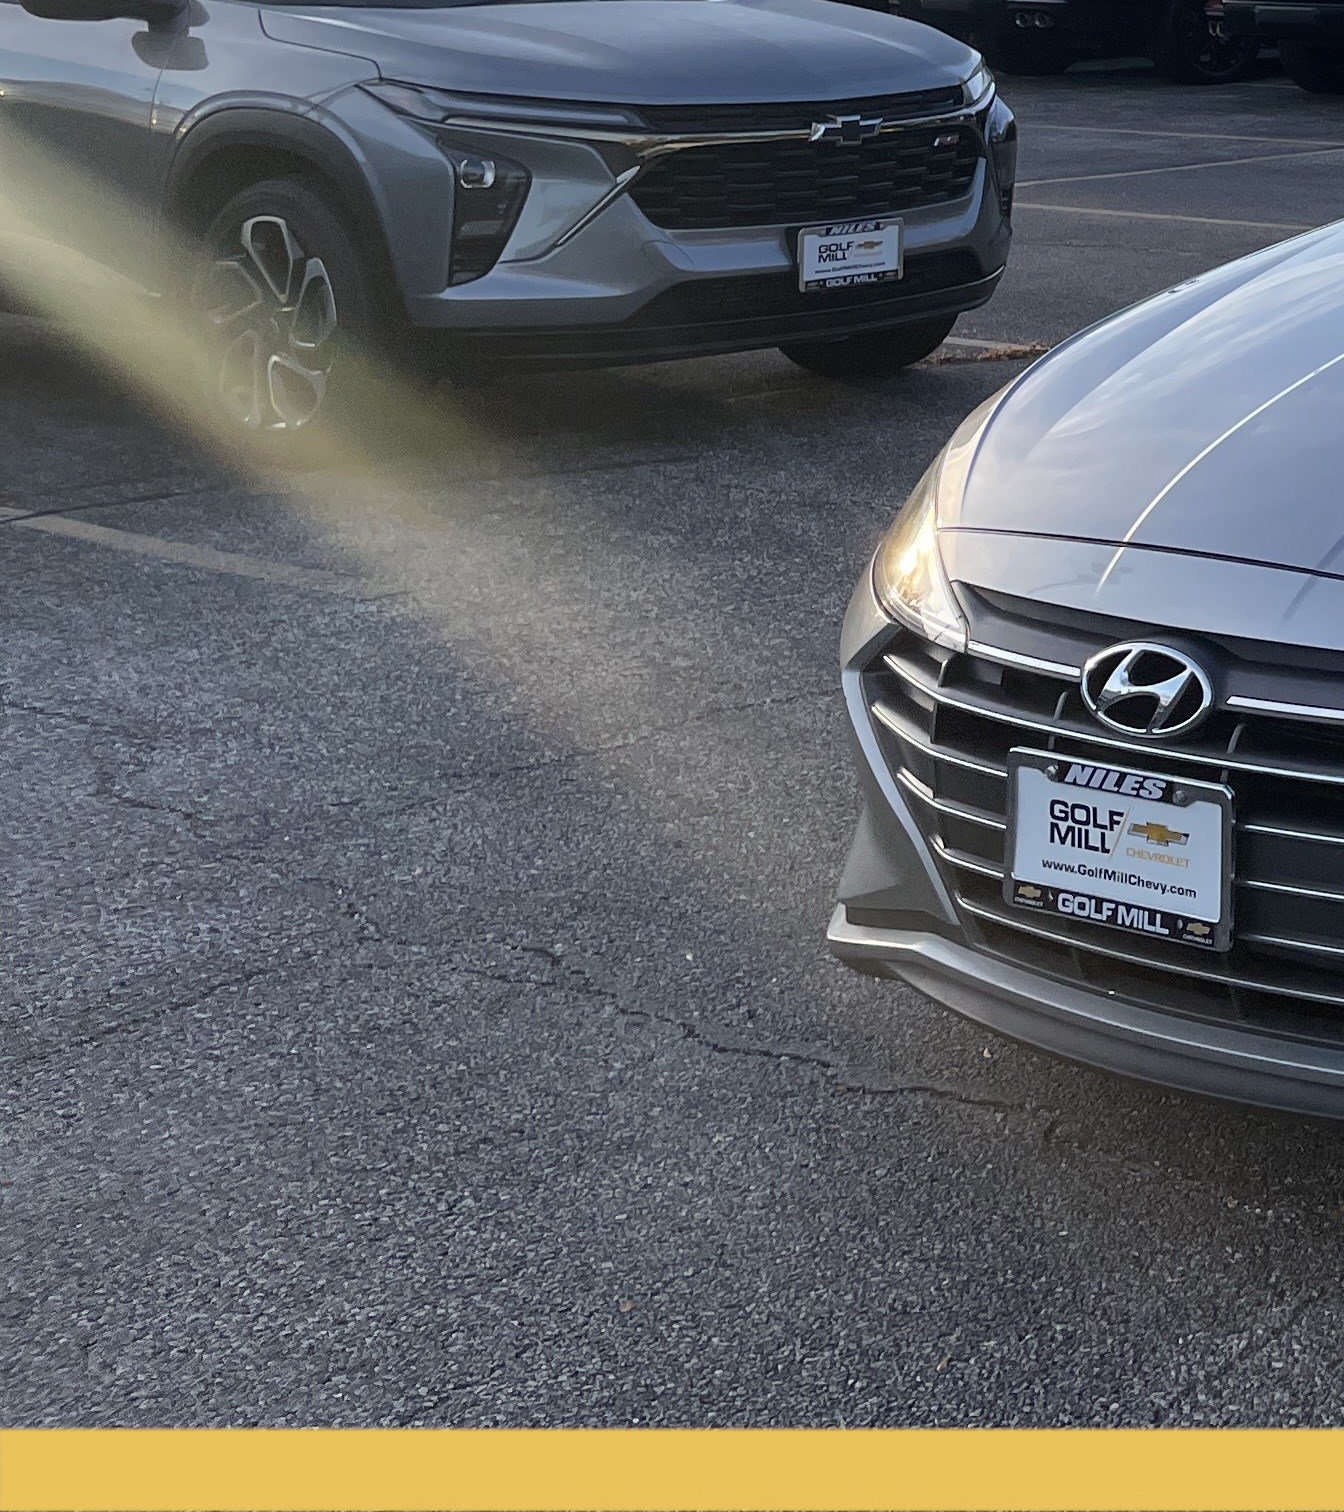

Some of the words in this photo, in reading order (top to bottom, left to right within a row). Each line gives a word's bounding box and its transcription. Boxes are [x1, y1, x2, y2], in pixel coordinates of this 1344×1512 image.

[817, 251, 848, 264] MILL
[818, 240, 855, 254] GOLF
[1065, 764, 1167, 800] NILES
[1049, 799, 1124, 832] GOLF
[1049, 822, 1111, 854] MILL
[1041, 858, 1197, 899] www.GolfMillChevy.com
[1057, 892, 1117, 922] GOLF
[1117, 903, 1170, 935] MILL
